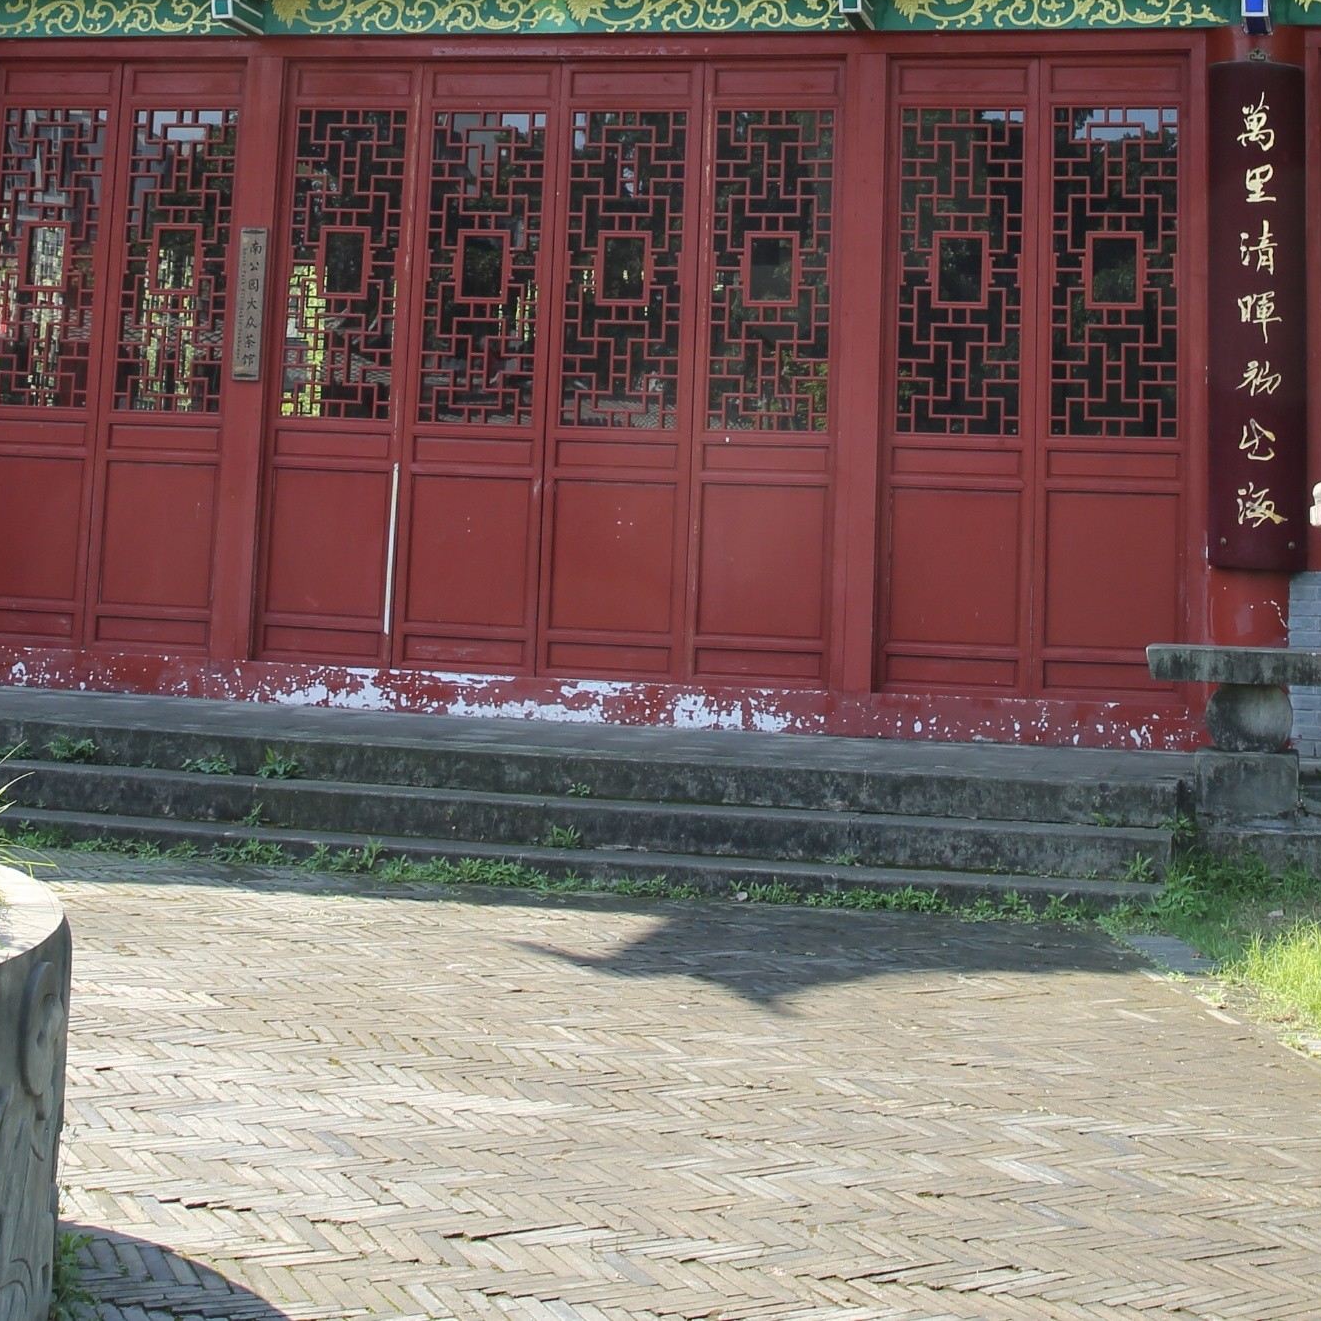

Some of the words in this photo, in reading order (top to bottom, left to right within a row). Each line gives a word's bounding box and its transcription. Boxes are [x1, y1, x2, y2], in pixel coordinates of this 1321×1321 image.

[241, 240, 263, 367] 南公园大众茶馆
